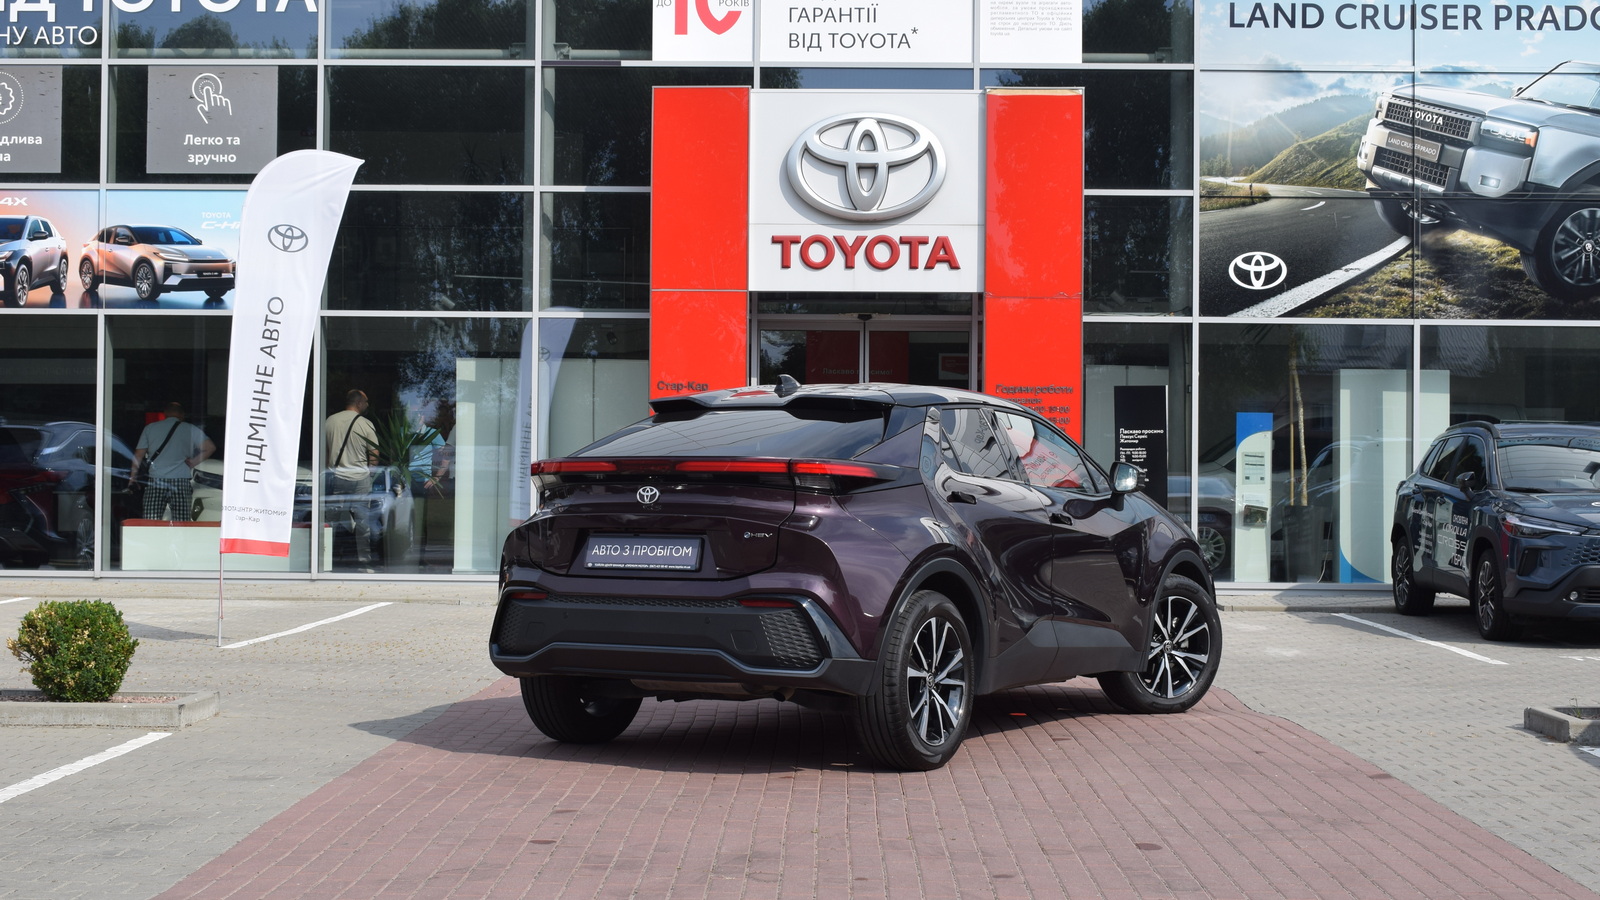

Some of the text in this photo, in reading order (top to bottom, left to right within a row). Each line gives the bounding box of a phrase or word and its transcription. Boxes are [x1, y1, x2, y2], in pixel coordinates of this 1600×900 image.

[789, 3, 879, 23] ГАРАНТІЇ
[1229, 3, 1325, 29] LAND
[1335, 3, 1484, 31] CRUISER
[33, 26, 98, 45] АВТО
[788, 33, 822, 52] ВІД
[183, 134, 241, 146] Легко та
[187, 154, 237, 166] зручно
[201, 211, 231, 219] TOYOTA
[771, 234, 961, 270] TOYOTA
[243, 296, 285, 484] ПІДМІННЕ АВТО
[657, 380, 709, 393] Стар-Кар
[1034, 383, 1073, 396] роботи
[253, 507, 288, 516] ЖИТОМИР
[591, 544, 621, 556] АВТО
[631, 544, 693, 557] ПРОБІГОМ
